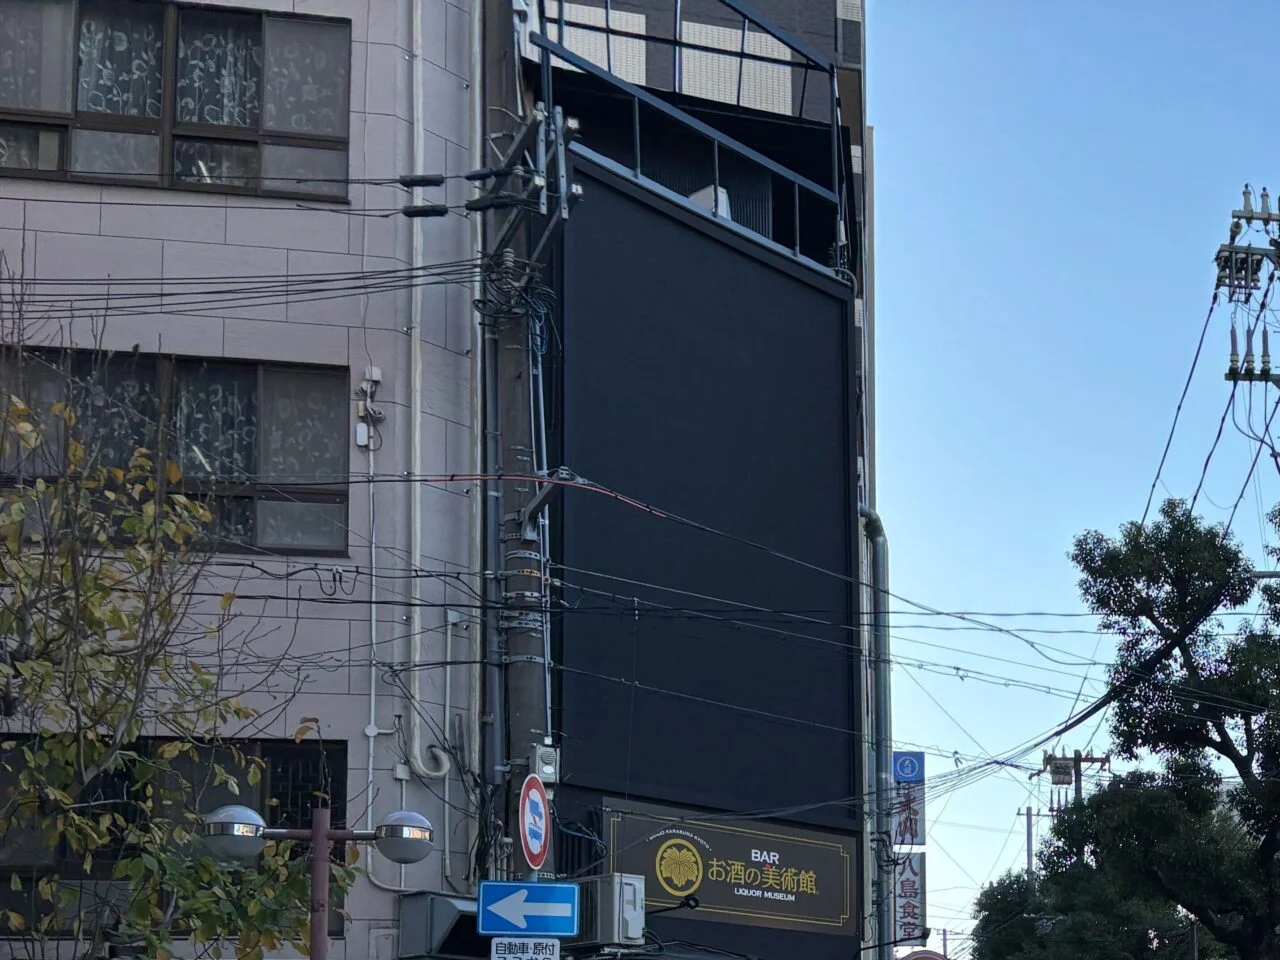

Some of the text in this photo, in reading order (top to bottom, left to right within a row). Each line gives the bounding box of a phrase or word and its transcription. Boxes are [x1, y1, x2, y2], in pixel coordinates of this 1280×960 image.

[751, 849, 779, 864] BAR
[708, 857, 817, 894] お酒の美術館
[734, 887, 795, 902] LIQUOR MUSEUM
[898, 857, 920, 940] 八島食堂
